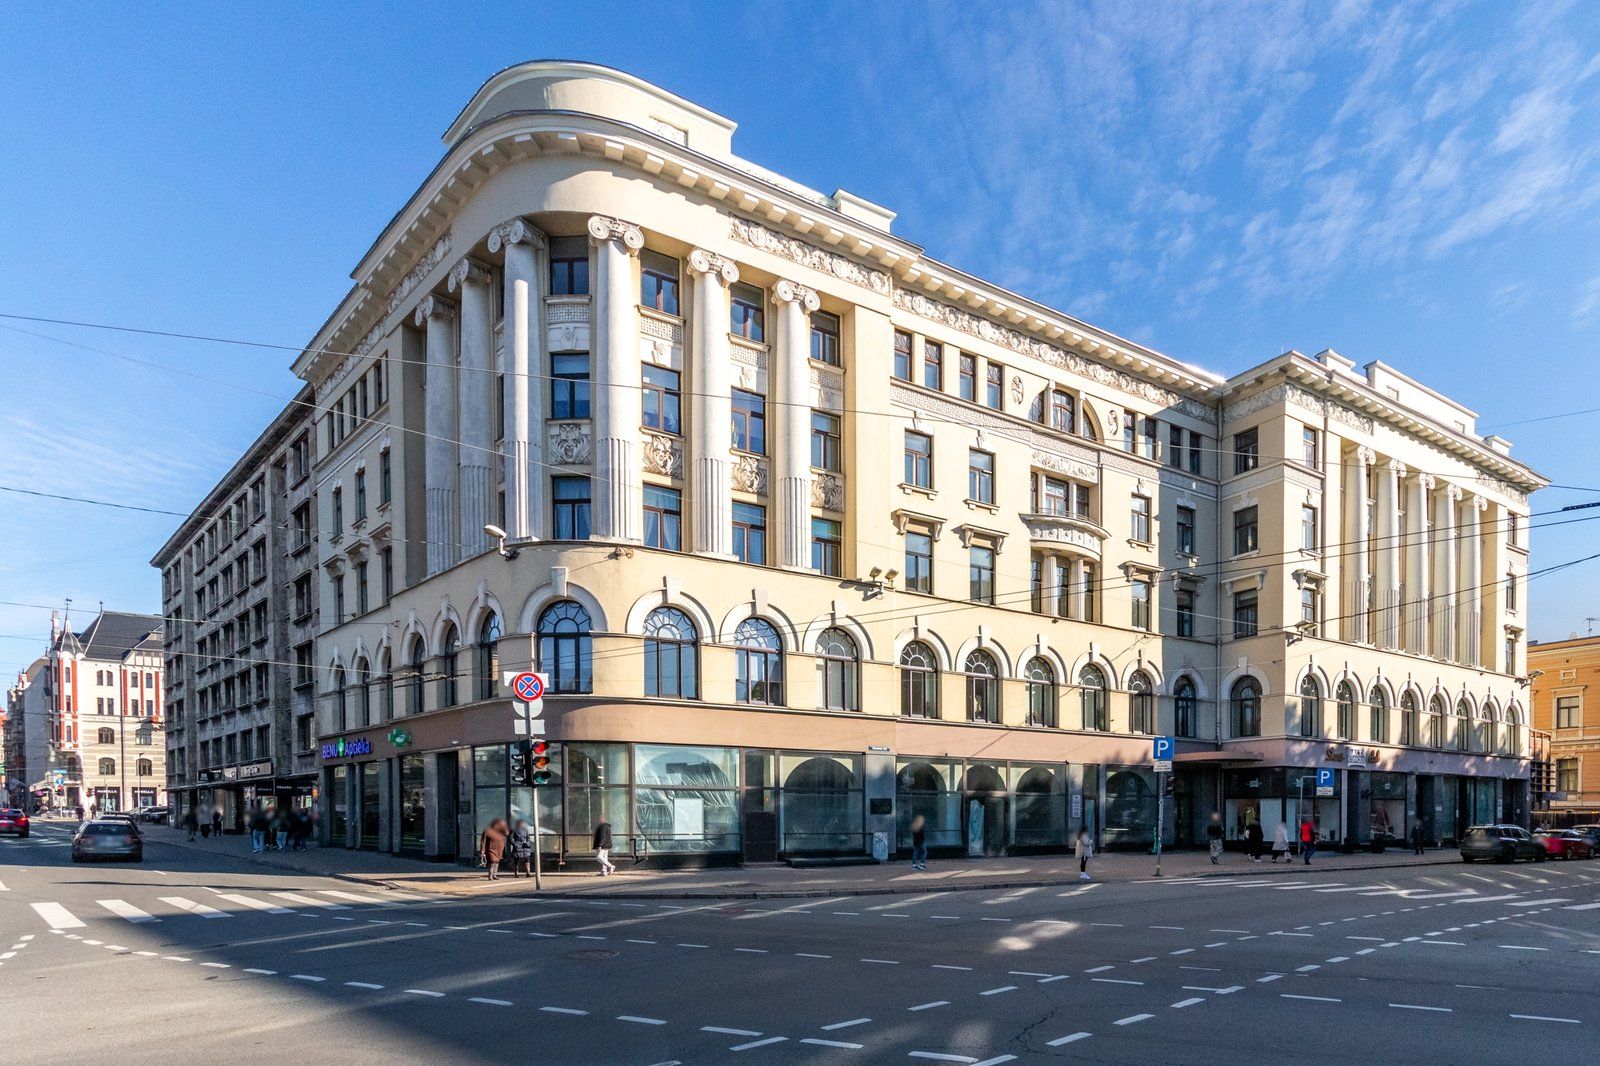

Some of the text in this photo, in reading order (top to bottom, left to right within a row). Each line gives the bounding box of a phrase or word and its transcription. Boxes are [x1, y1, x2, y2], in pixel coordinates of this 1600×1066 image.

[322, 737, 372, 759] BENU Aptieka
[1157, 740, 1169, 757] P
[1320, 771, 1330, 784] P
